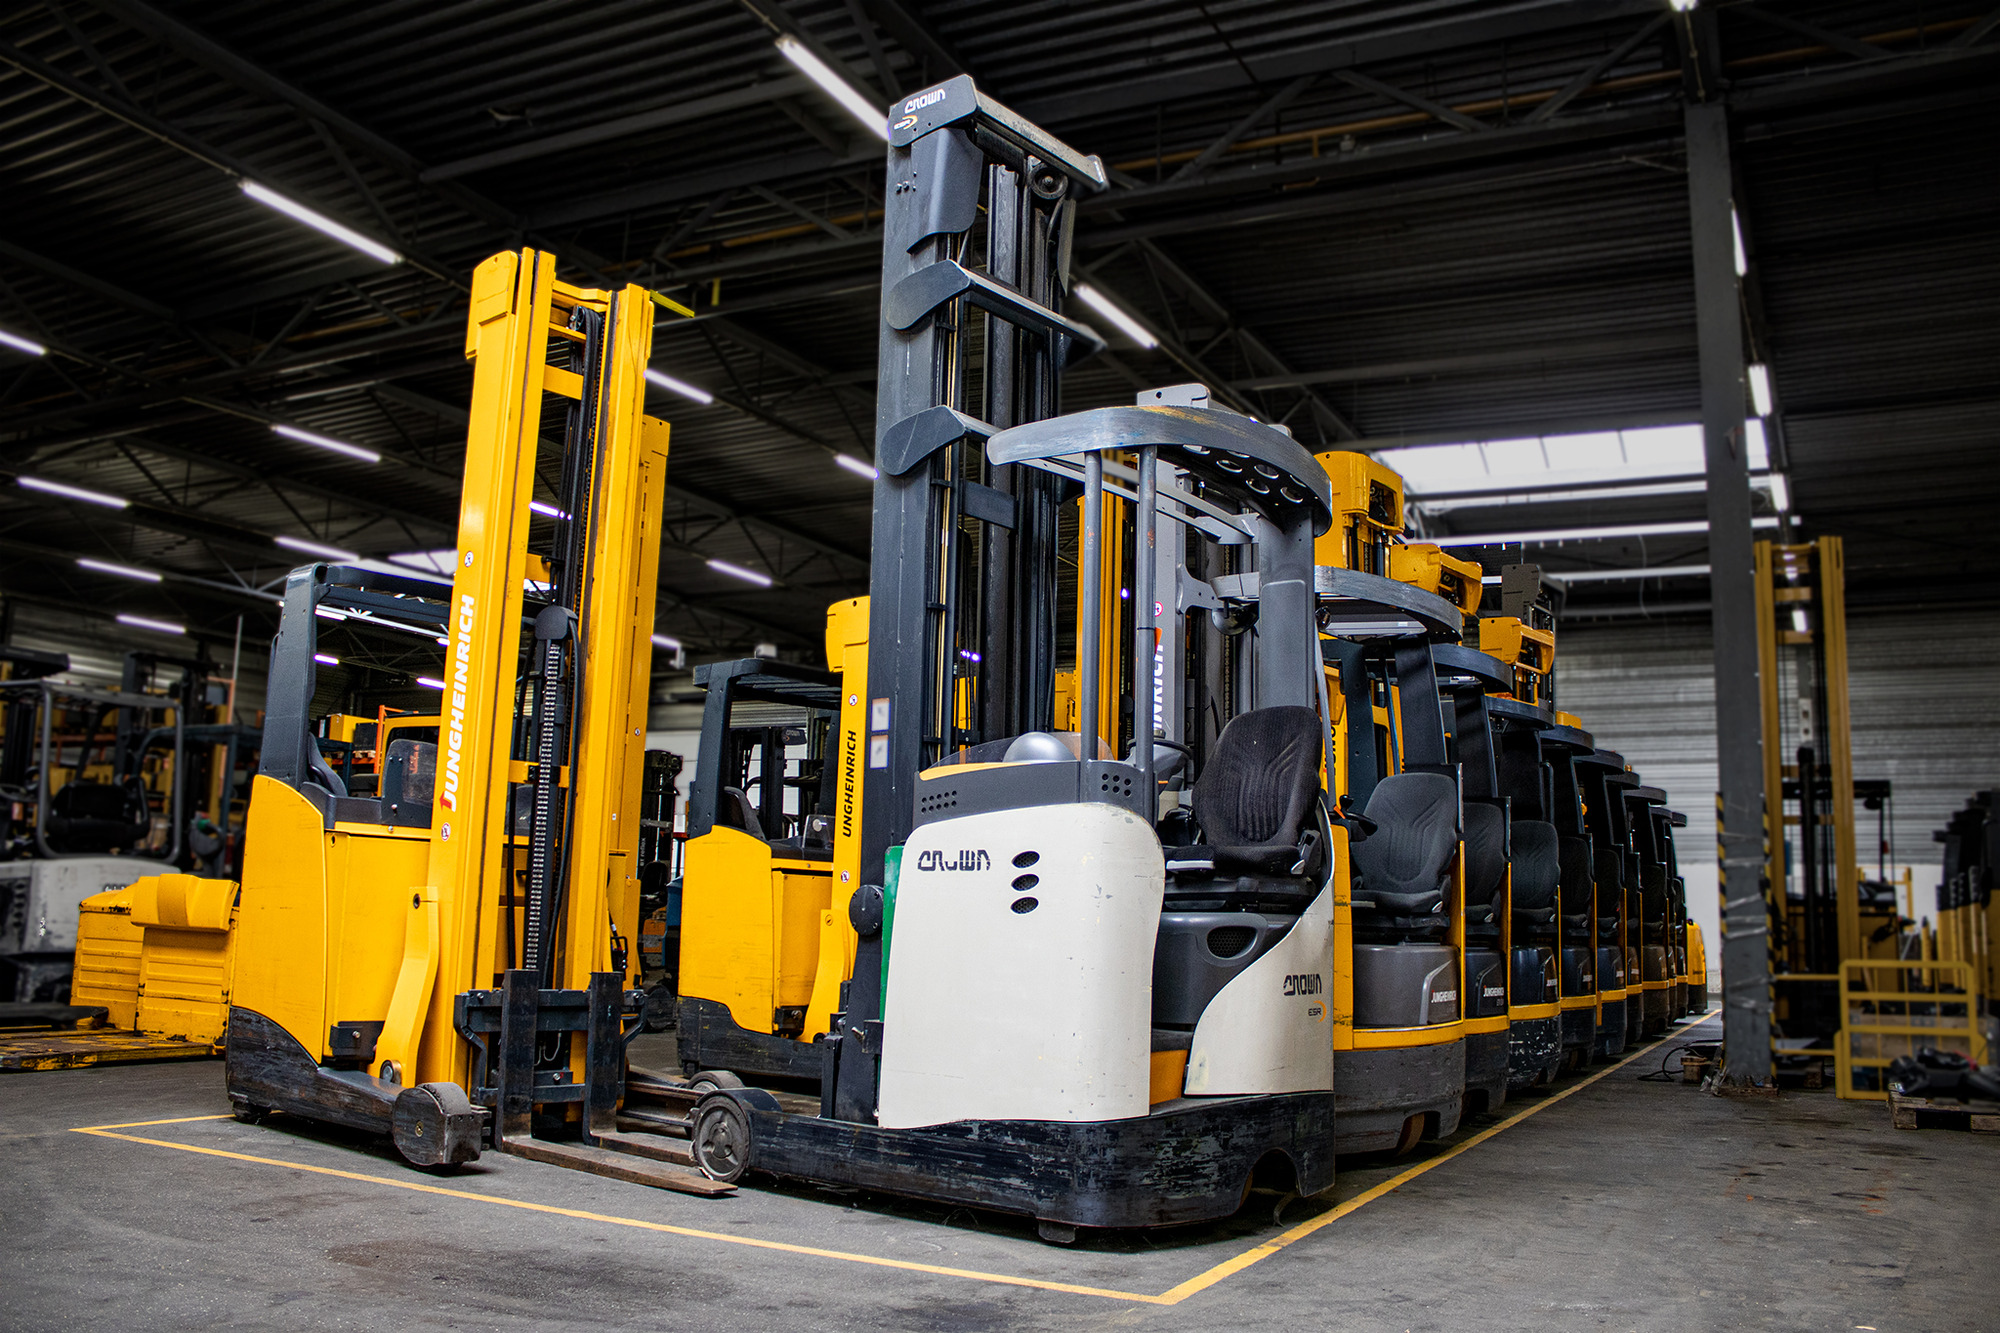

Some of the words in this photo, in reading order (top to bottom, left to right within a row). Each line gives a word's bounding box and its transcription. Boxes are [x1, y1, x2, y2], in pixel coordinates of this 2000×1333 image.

[904, 88, 946, 114] CROWN
[440, 594, 475, 812] JUNGHEINRICH
[1283, 973, 1322, 996] CROWN
[1308, 1008, 1322, 1016] ESR
